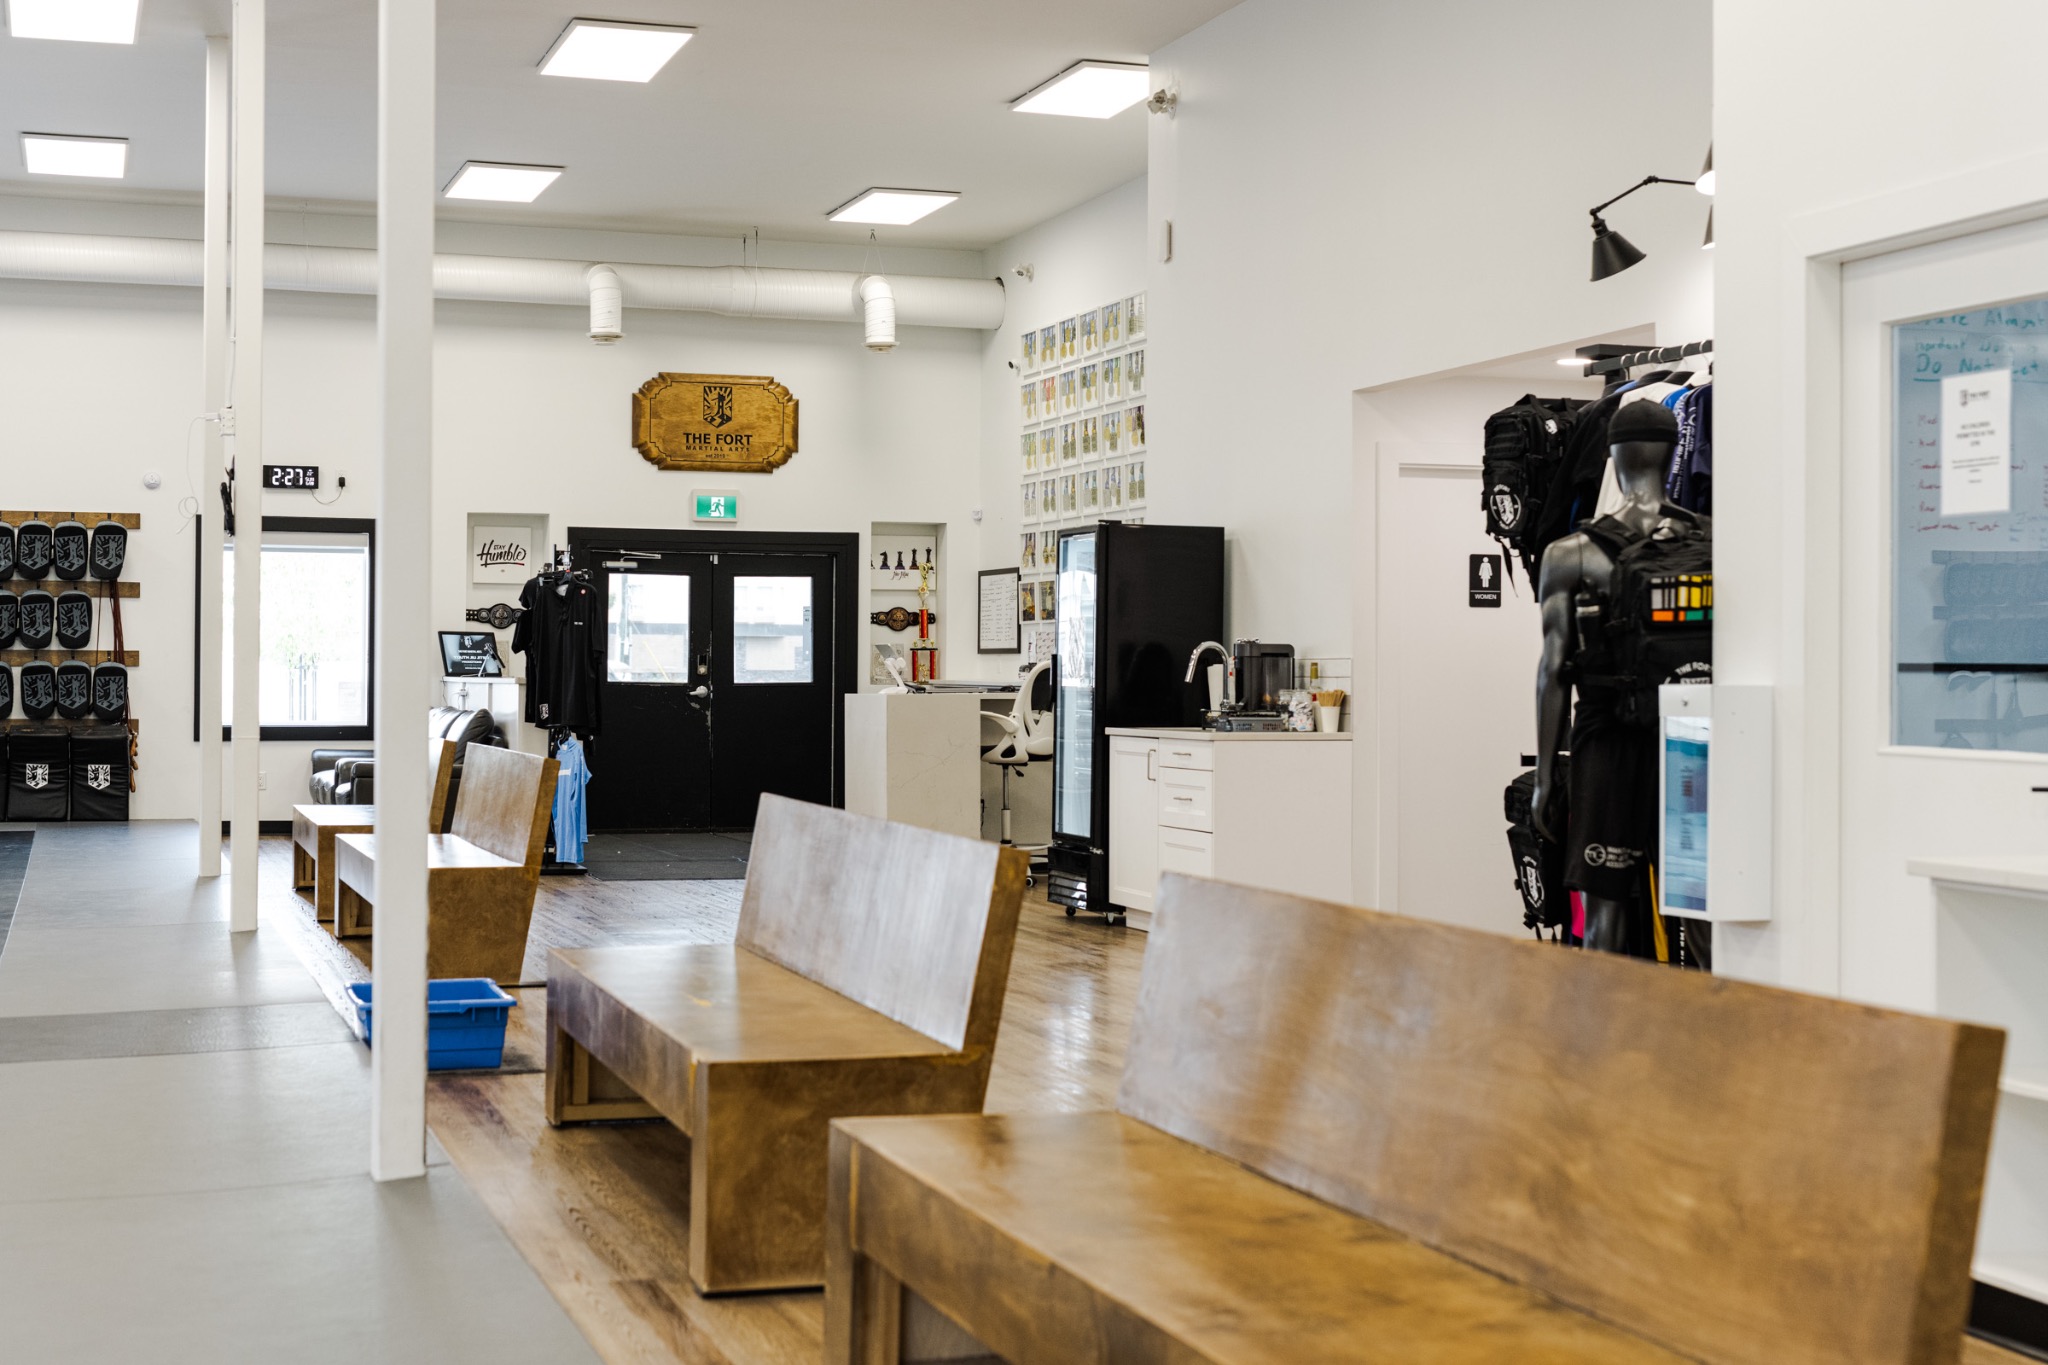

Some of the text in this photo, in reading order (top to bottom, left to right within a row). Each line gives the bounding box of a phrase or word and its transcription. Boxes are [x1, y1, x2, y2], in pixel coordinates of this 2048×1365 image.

[682, 432, 753, 446] THE FORT
[272, 467, 304, 486] 2:27
[476, 539, 527, 568] Humble
[1674, 661, 1712, 676] THE FOR
